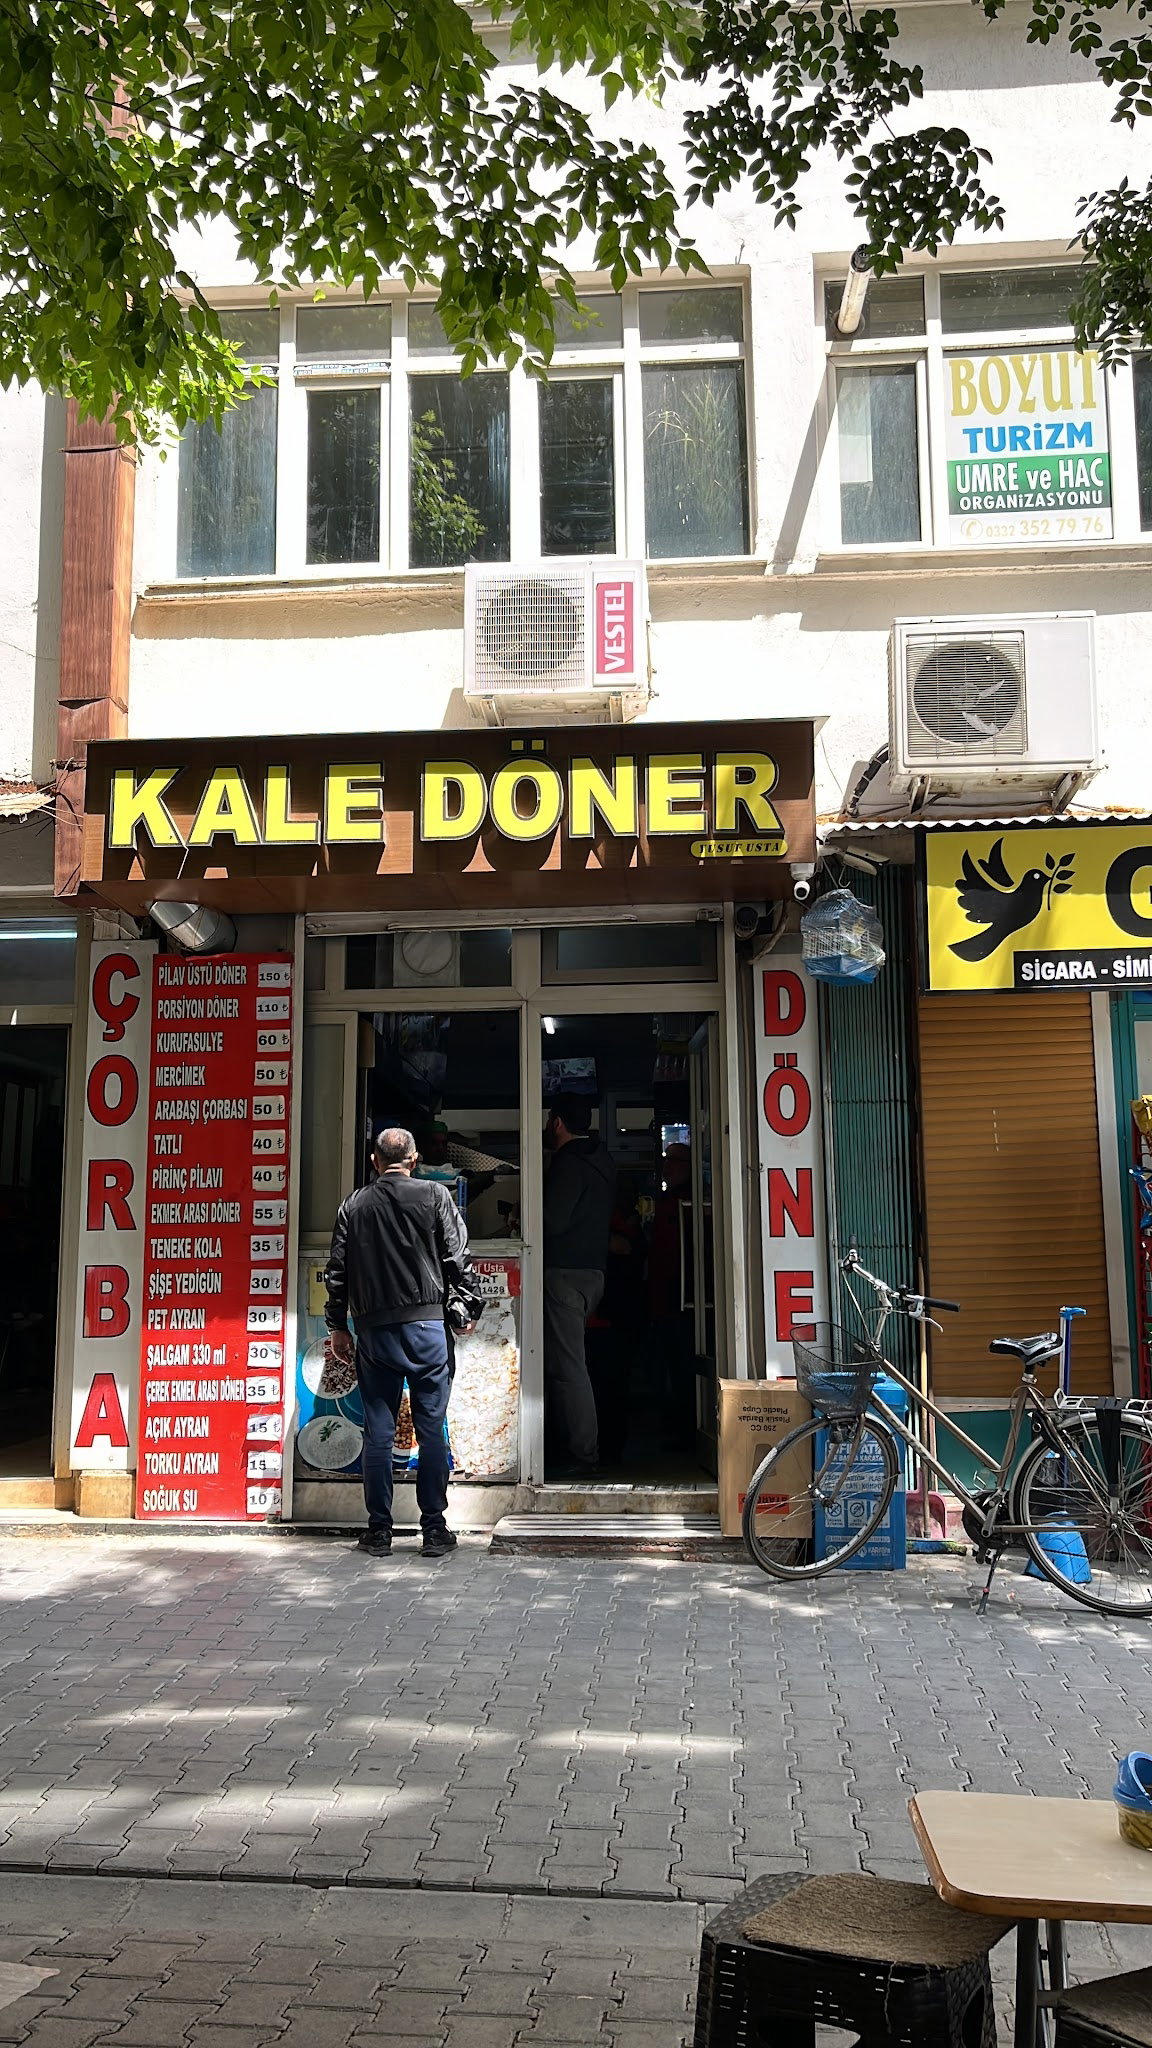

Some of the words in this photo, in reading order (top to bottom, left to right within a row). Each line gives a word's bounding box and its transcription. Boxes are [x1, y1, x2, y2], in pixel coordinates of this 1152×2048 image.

[949, 350, 1099, 417] BOYUT
[956, 462, 1019, 494] UMRE
[1026, 469, 1052, 490] ve
[1058, 458, 1104, 488] HAC
[986, 524, 1015, 537] 0332
[1020, 519, 1050, 536] 352
[1057, 518, 1076, 534] 79
[1082, 517, 1104, 533] 76
[604, 583, 625, 672] VESTEL
[108, 760, 385, 847] KALE
[420, 738, 785, 844] DÖNER
[746, 842, 779, 852] USTA
[158, 964, 184, 986] PİLAV
[188, 962, 212, 984] ÜSTÜ
[215, 962, 246, 984] DÖNER
[259, 972, 280, 981] 150
[1022, 958, 1097, 981] SİGARA
[158, 996, 204, 1018] PORSİYON
[206, 994, 238, 1018] DÖNER
[257, 1004, 278, 1012] 110
[156, 1032, 223, 1052] KURUFASULYE
[258, 1034, 276, 1046] 60
[156, 1062, 206, 1086] MERCİMEK
[256, 1069, 275, 1080] 50
[154, 1100, 199, 1124] ARABAŞI
[202, 1098, 248, 1124] ÇORBASI
[254, 1104, 272, 1115] 50
[154, 1134, 182, 1154] TATLI
[253, 1138, 272, 1150] 40
[152, 1164, 186, 1194] PİRİNÇ
[190, 1164, 223, 1188] PİLAVI
[253, 1170, 272, 1182] 40
[764, 970, 816, 1381] DÖNE
[74, 952, 140, 1448] ÇORBA
[151, 1202, 181, 1224] EKMEK
[183, 1202, 208, 1222] ARASI
[210, 1198, 240, 1222] DÖNER
[254, 1208, 272, 1219] 55
[150, 1238, 192, 1258] TENEKE
[194, 1237, 222, 1258] KOLA
[252, 1241, 270, 1252] 35
[484, 1264, 504, 1272] Usta
[149, 1269, 172, 1300] ŞİŞE
[175, 1268, 222, 1294] YEDİGÜN
[252, 1278, 270, 1288] 30
[148, 1309, 168, 1330] PET
[170, 1308, 205, 1329] AYRAN
[249, 1312, 267, 1322] 30
[147, 1344, 189, 1371] ŞALGAM
[192, 1345, 210, 1366] 330
[213, 1344, 226, 1365] ml
[250, 1347, 268, 1358] 30
[172, 1380, 196, 1402] EKMEK
[198, 1380, 218, 1402] ARASI
[220, 1376, 245, 1401] DÖNER
[248, 1386, 266, 1396] 35
[146, 1416, 170, 1443] AÇIK
[174, 1416, 209, 1438] AYRAN
[250, 1422, 268, 1433] 15
[146, 1454, 180, 1475] TORKU
[183, 1452, 218, 1474] AYRAN
[250, 1460, 266, 1470] 15
[144, 1486, 180, 1512] SOĞUK
[183, 1490, 197, 1511] SU
[250, 1494, 267, 1504] 10
